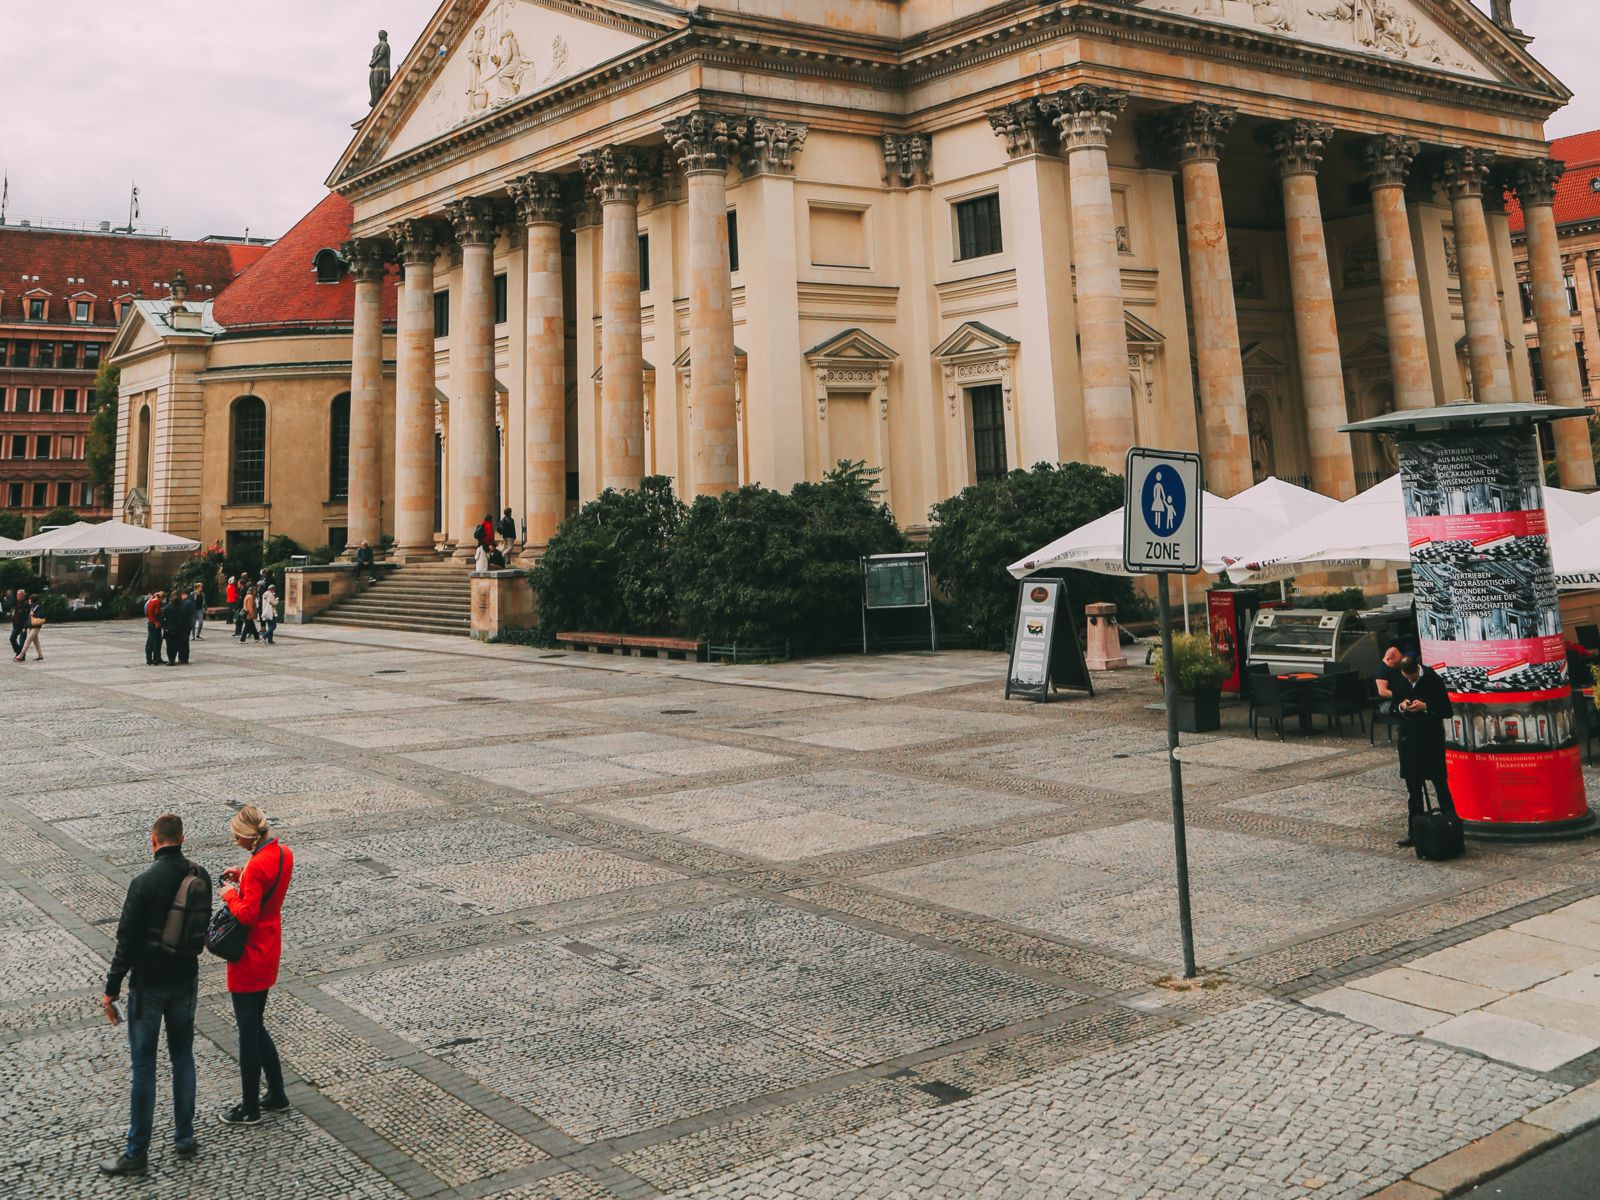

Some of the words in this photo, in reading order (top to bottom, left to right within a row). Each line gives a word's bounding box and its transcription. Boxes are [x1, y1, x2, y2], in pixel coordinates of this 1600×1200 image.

[1436, 448, 1474, 456] VERTRIEBEN
[1451, 454, 1498, 462] RASSISTISCHEN
[1440, 471, 1451, 479] DIE
[1440, 476, 1496, 486] WISSENSCHAFTEN
[1145, 542, 1180, 560] ZONE
[1451, 572, 1491, 580] VERTRIEBEN
[1555, 572, 1600, 585] PAULA
[1467, 578, 1516, 587] RASSISTISCHEN
[1467, 594, 1503, 602] AKADEMIE
[1504, 593, 1517, 601] DER
[1456, 601, 1514, 611] WISSENSCHAFTEN
